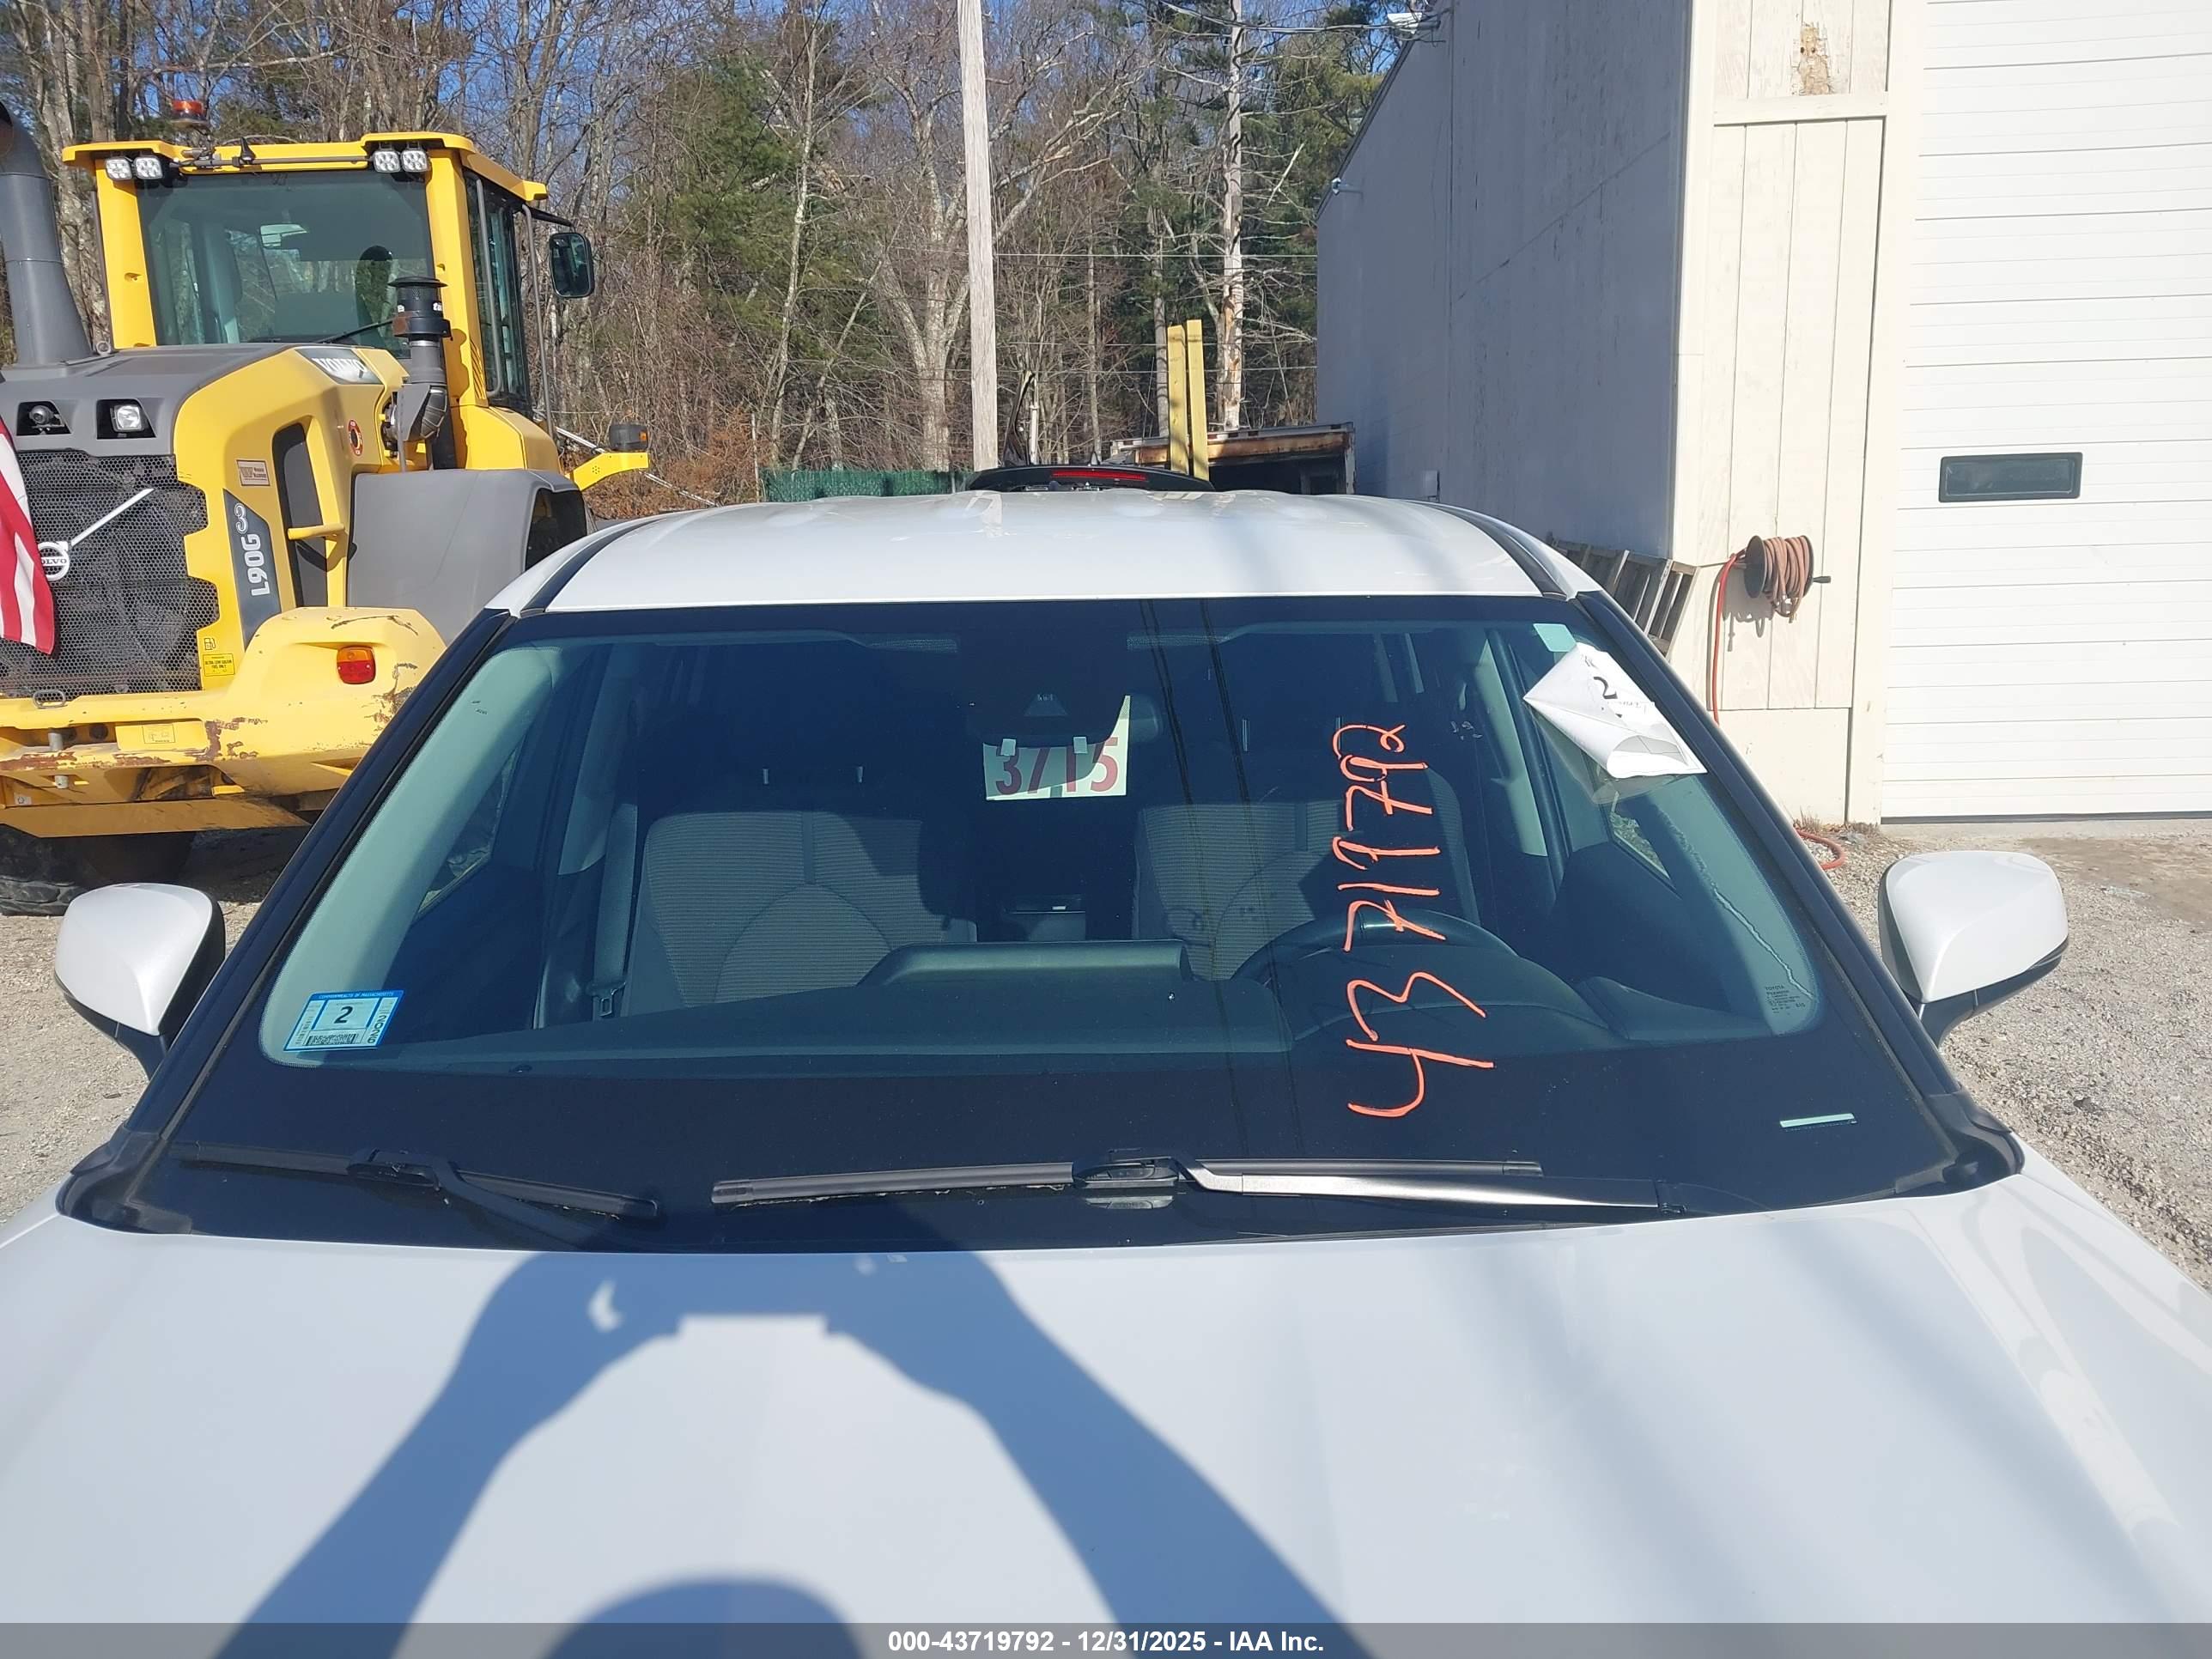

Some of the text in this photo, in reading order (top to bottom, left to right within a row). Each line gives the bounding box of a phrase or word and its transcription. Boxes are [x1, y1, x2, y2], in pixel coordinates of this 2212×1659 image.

[311, 357, 368, 373] VOLVO
[240, 532, 271, 597] L90G
[333, 1006, 354, 1024] 2
[367, 1014, 387, 1044] 2026
